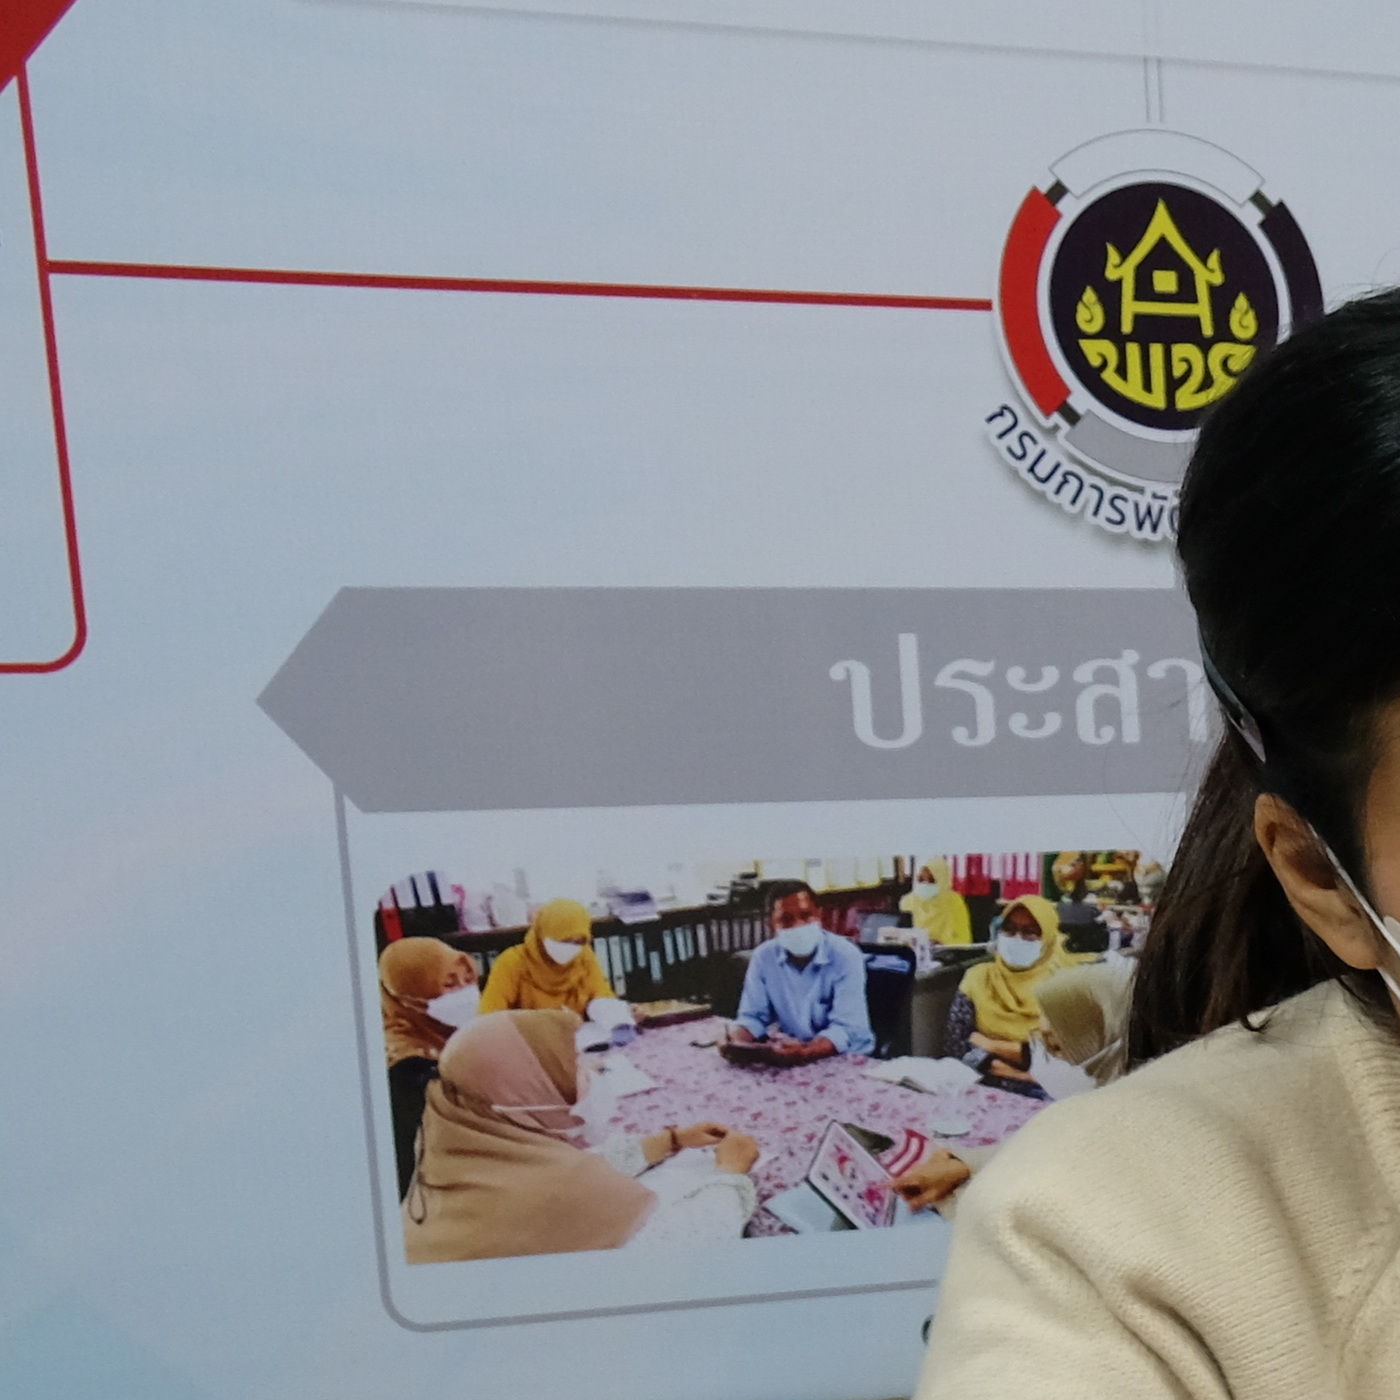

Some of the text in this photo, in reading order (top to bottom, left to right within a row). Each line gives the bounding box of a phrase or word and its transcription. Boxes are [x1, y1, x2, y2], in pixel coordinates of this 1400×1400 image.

[985, 402, 1179, 535] กรมการพั
[828, 632, 1209, 749] ประสา
